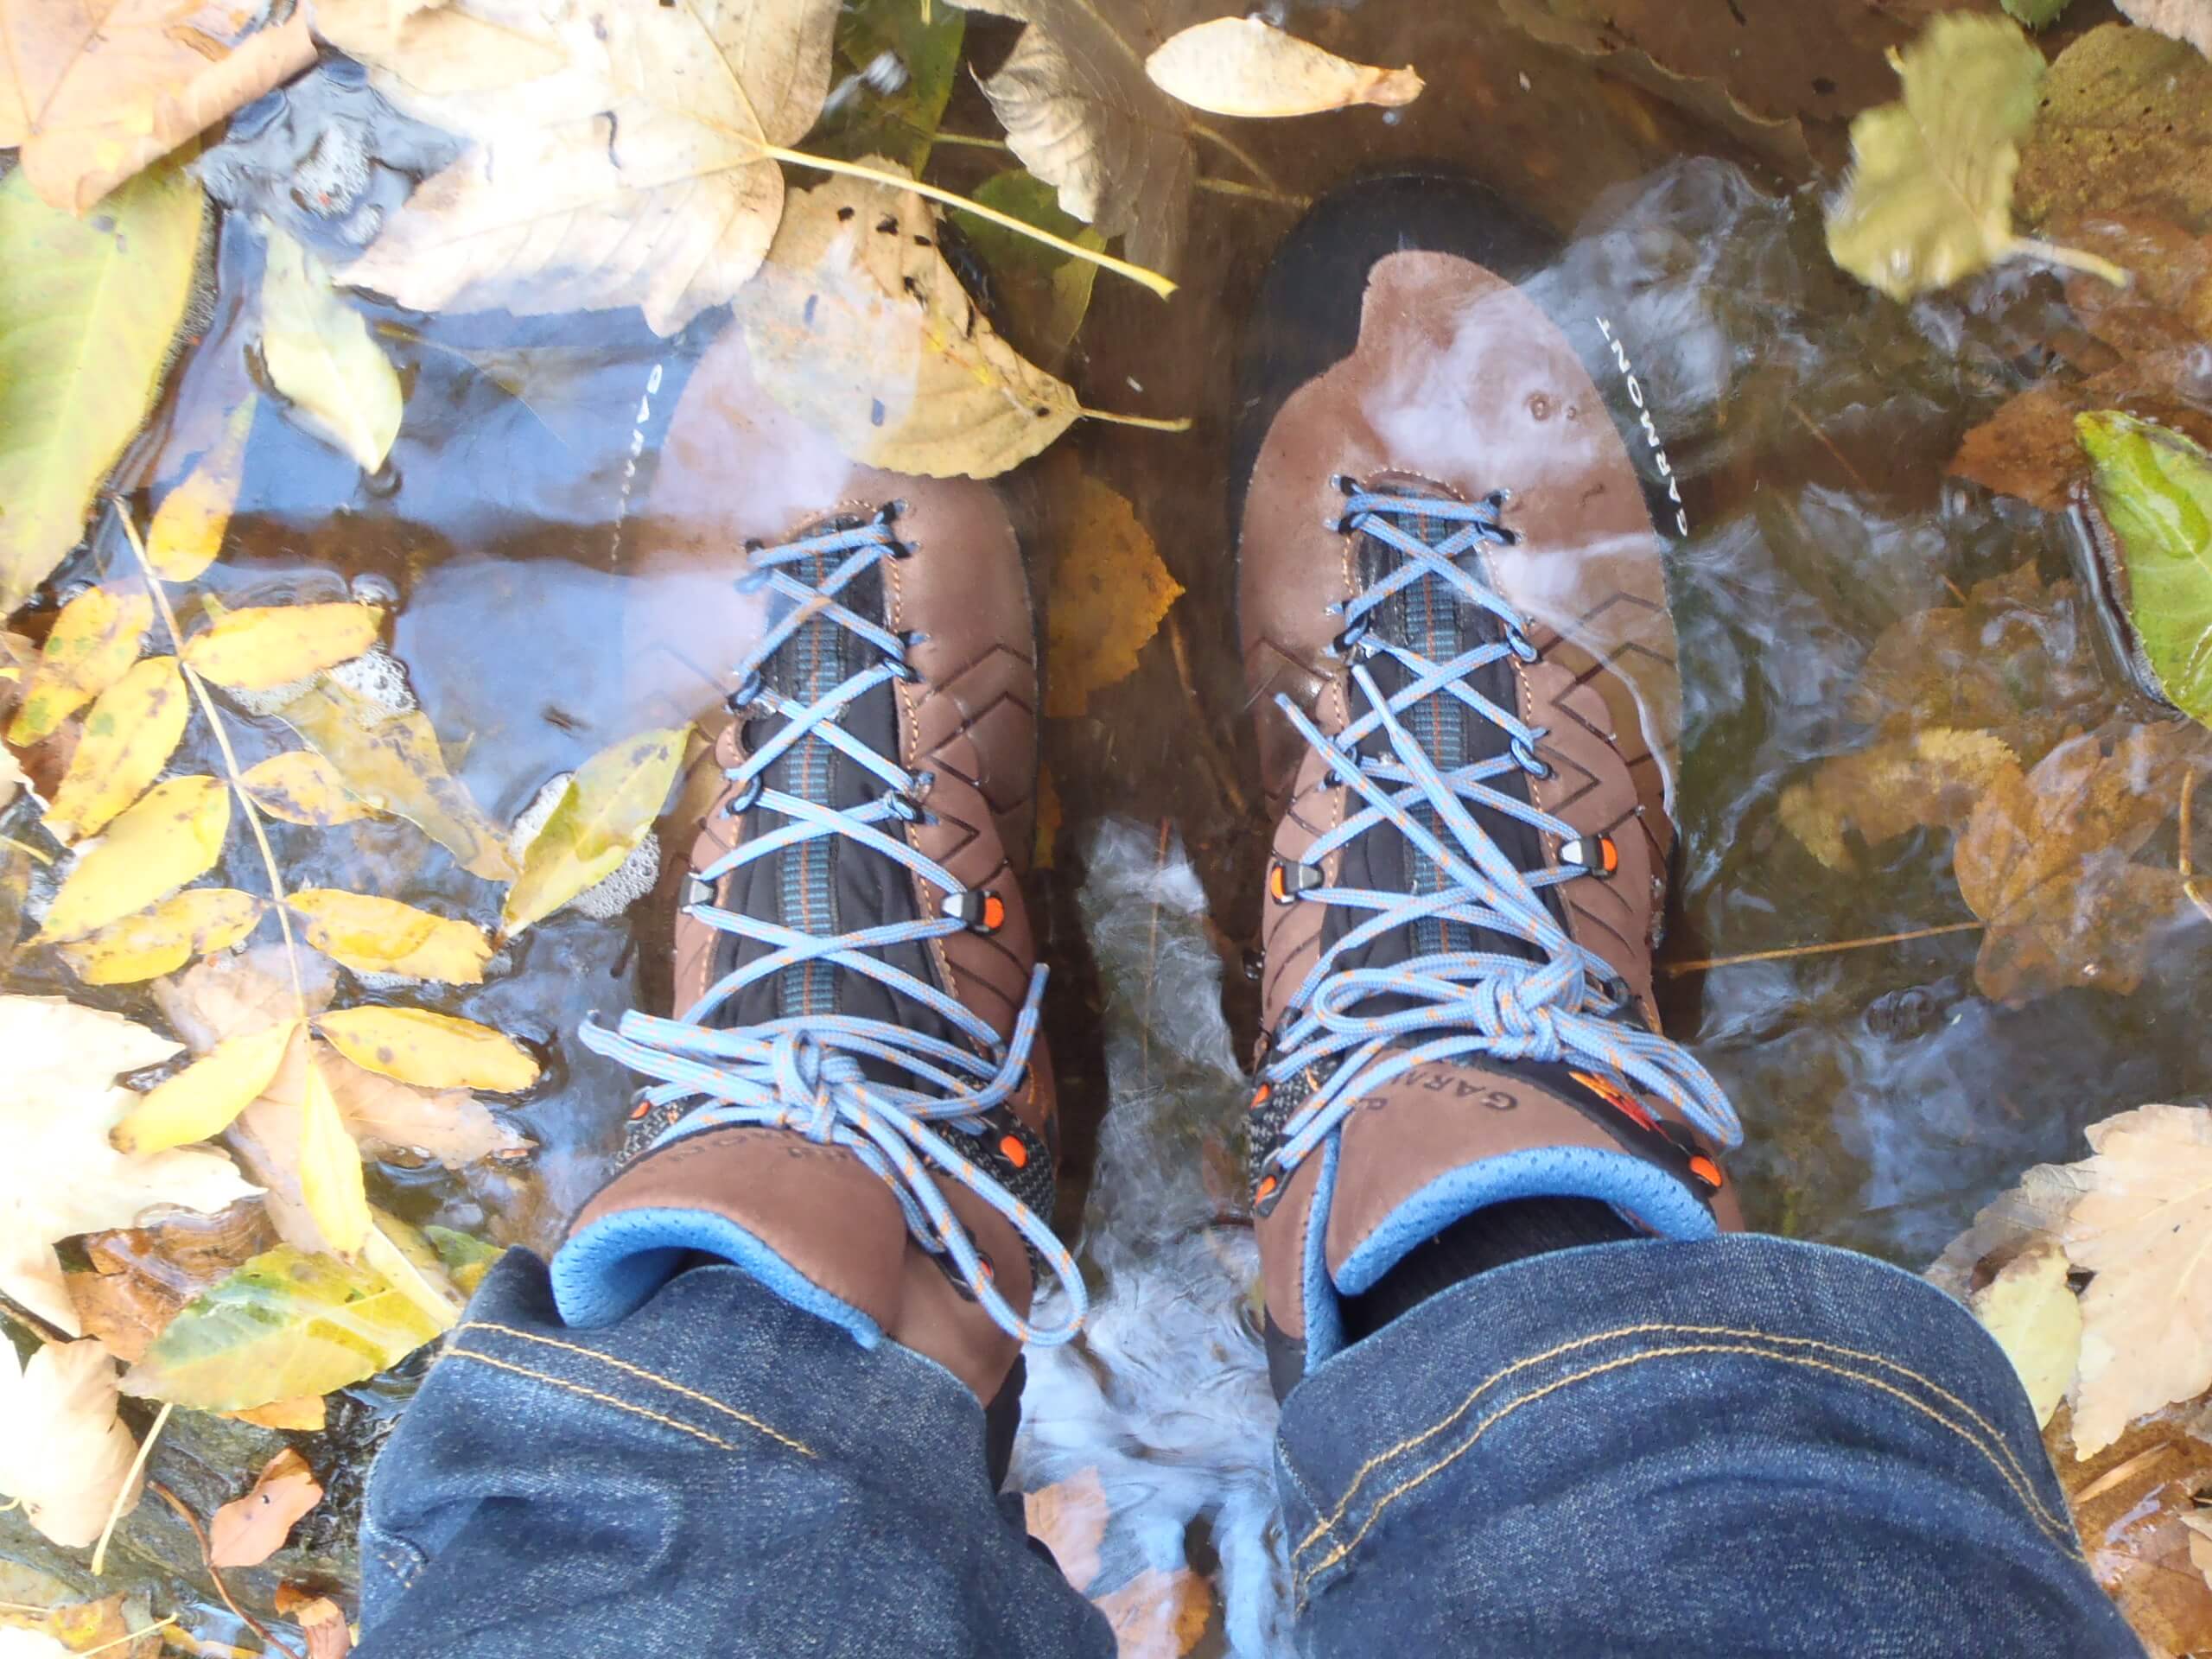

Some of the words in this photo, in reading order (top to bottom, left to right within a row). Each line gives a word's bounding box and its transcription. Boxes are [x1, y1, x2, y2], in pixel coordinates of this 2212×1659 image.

[608, 363, 664, 566] GARMON
[1595, 315, 1688, 537] GARMONT
[1391, 1069, 1519, 1112] GARM
